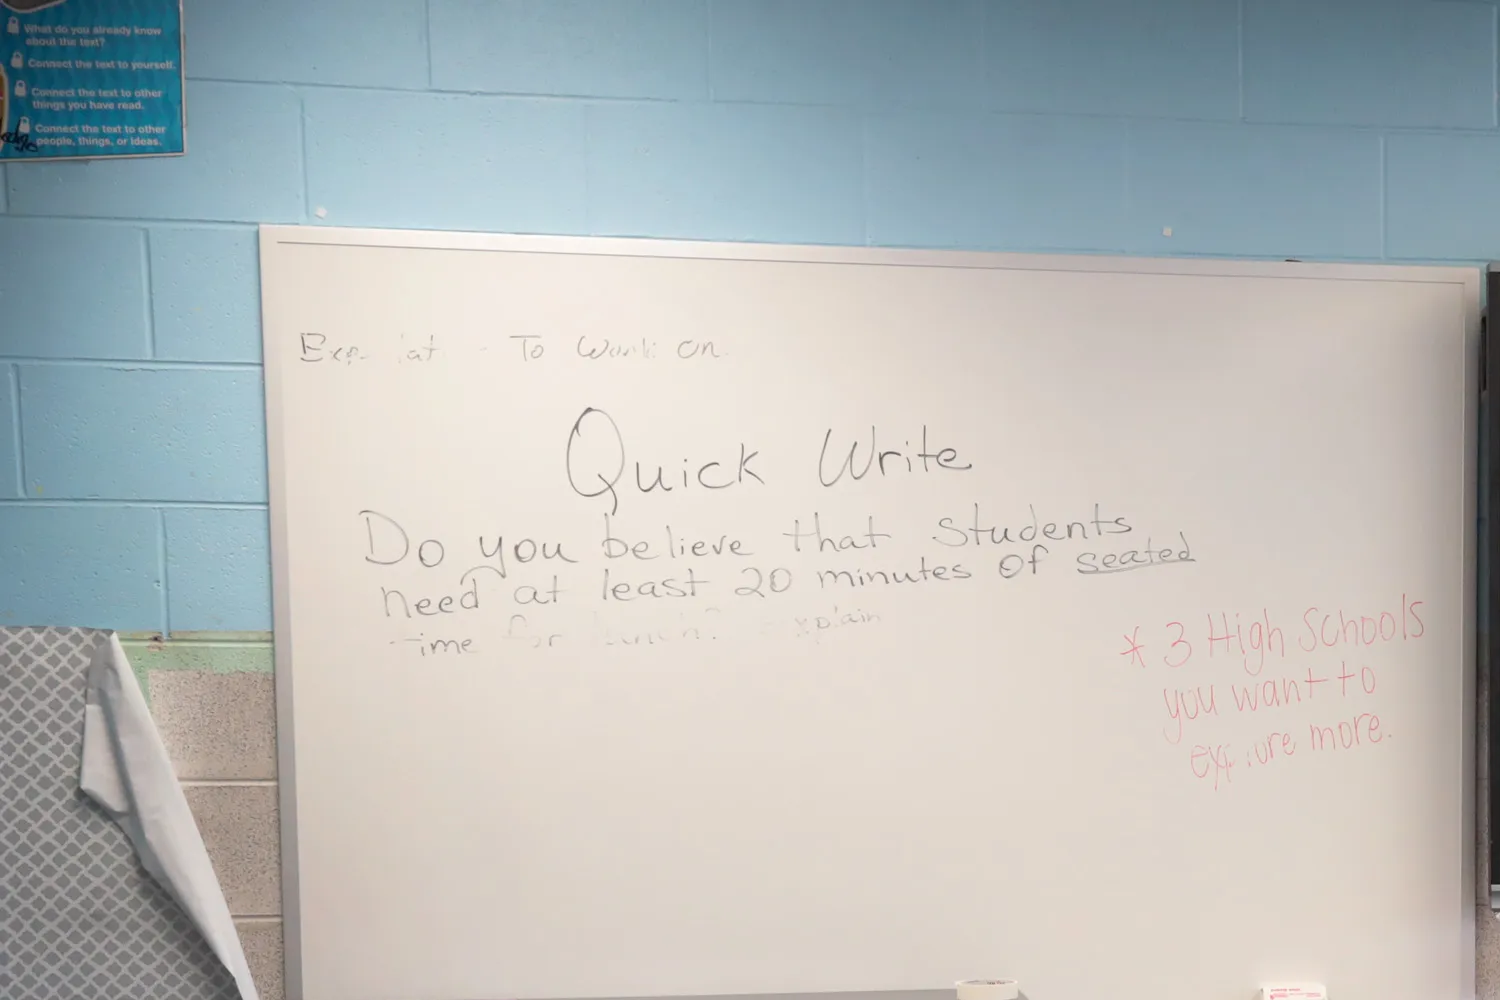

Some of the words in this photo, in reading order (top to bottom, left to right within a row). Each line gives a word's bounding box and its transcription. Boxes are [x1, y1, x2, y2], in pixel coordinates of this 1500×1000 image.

[24, 24, 52, 34] What
[55, 25, 68, 34] do
[71, 26, 90, 36] you
[93, 25, 131, 36] already
[134, 26, 162, 35] know
[26, 38, 56, 47] about
[60, 38, 77, 47] the
[80, 38, 106, 47] text?
[28, 59, 73, 69] Connect
[75, 59, 92, 69] the
[95, 60, 116, 69] text
[118, 60, 129, 69] to
[31, 87, 76, 97] Connect
[78, 87, 96, 97] the
[98, 88, 118, 98] text
[121, 88, 132, 98] to
[134, 88, 163, 98] other
[32, 101, 66, 111] things
[68, 101, 87, 111] you
[89, 101, 115, 110] have
[117, 100, 145, 110] read.
[35, 124, 79, 134] Connect
[82, 124, 99, 134] the
[102, 124, 122, 134] text
[125, 124, 135, 134] to
[138, 124, 166, 134] other
[117, 137, 128, 146] or
[508, 334, 544, 362] To
[567, 407, 765, 516] Quick
[818, 425, 973, 487] Write
[359, 510, 445, 568] Do
[460, 535, 580, 586] you
[603, 512, 757, 561] believe
[782, 512, 891, 553] that
[513, 575, 563, 605] at
[603, 568, 710, 601] least
[735, 567, 793, 599] 20
[818, 556, 972, 588] minutes
[1076, 531, 1196, 575] seated
[1163, 621, 1192, 668] 3
[1207, 608, 1285, 676] High
[1163, 684, 1218, 745] you
[1231, 667, 1329, 713] want
[1337, 661, 1376, 697] to
